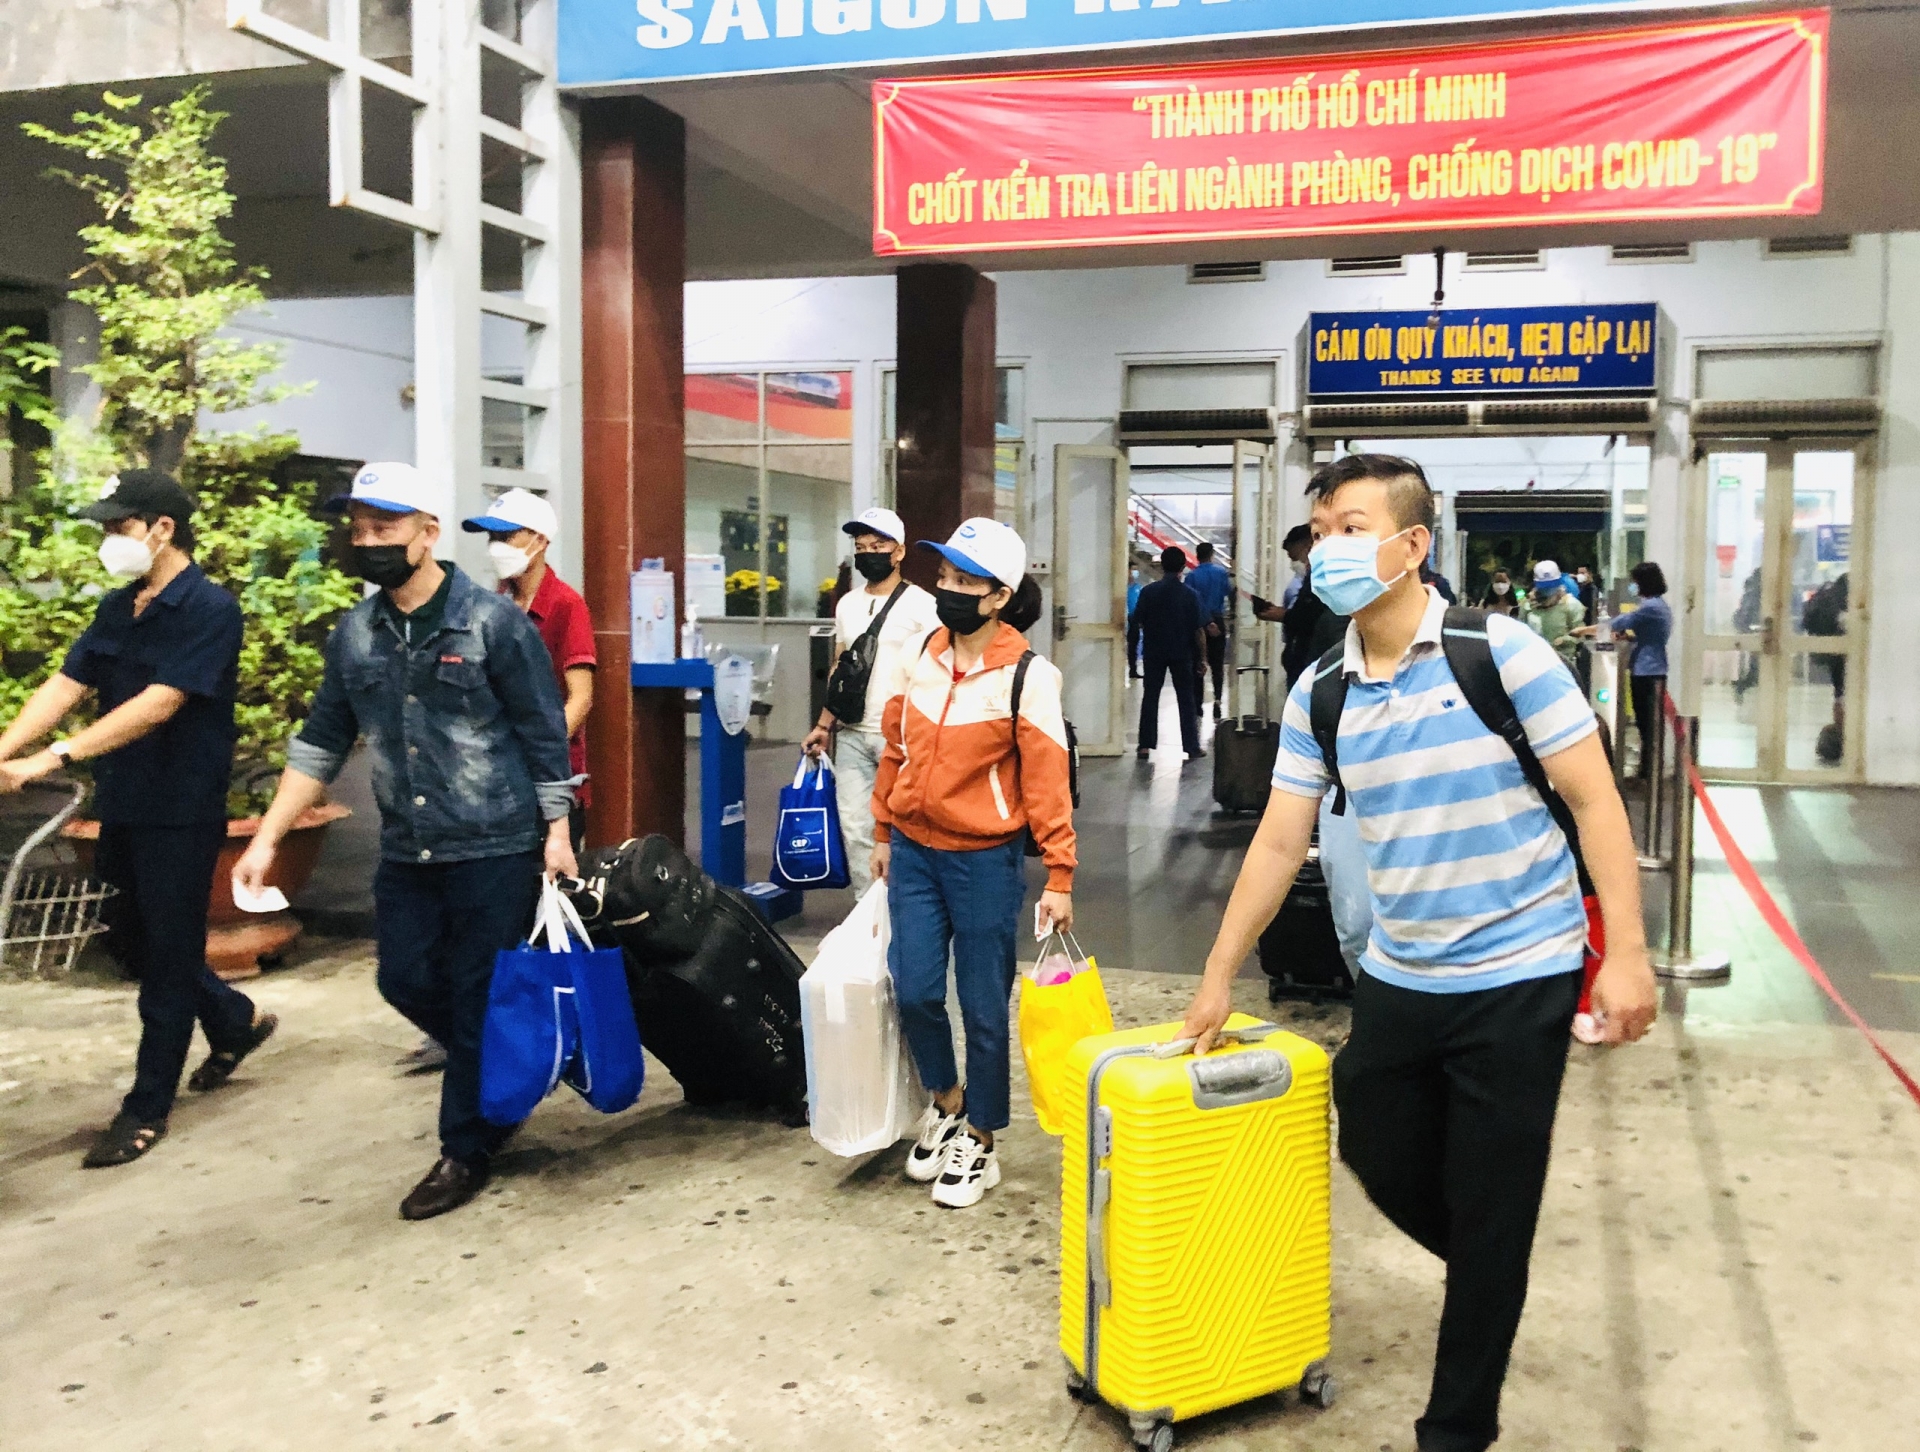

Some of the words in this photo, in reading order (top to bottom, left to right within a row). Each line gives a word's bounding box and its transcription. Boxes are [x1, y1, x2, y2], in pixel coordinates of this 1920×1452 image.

[1133, 84, 1245, 139] “THÀNH
[1252, 72, 1317, 133] PHỐ
[1317, 69, 1361, 129] HỒ
[1366, 68, 1420, 126] CHÍ
[1424, 72, 1506, 122] MINH
[907, 167, 978, 226] CHỐT
[983, 158, 1050, 222] KIỂM
[1055, 172, 1111, 218] TRA
[1116, 161, 1179, 215] LIÊN
[1185, 156, 1285, 212] NGÀNH
[1291, 149, 1401, 207] PHÒNG,
[1408, 138, 1513, 200] CHỐNG
[1519, 144, 1596, 203] DỊCH
[1315, 321, 1360, 362] CÁM
[1442, 316, 1515, 362] KHÁCH,
[1520, 322, 1564, 365] HẸN
[1568, 315, 1611, 364] GẶP
[1616, 320, 1650, 363] LẠI
[1379, 369, 1442, 386] THANKS
[1451, 368, 1485, 385] SEE
[1489, 367, 1525, 383] YOU
[1528, 366, 1580, 383] AGAIN
